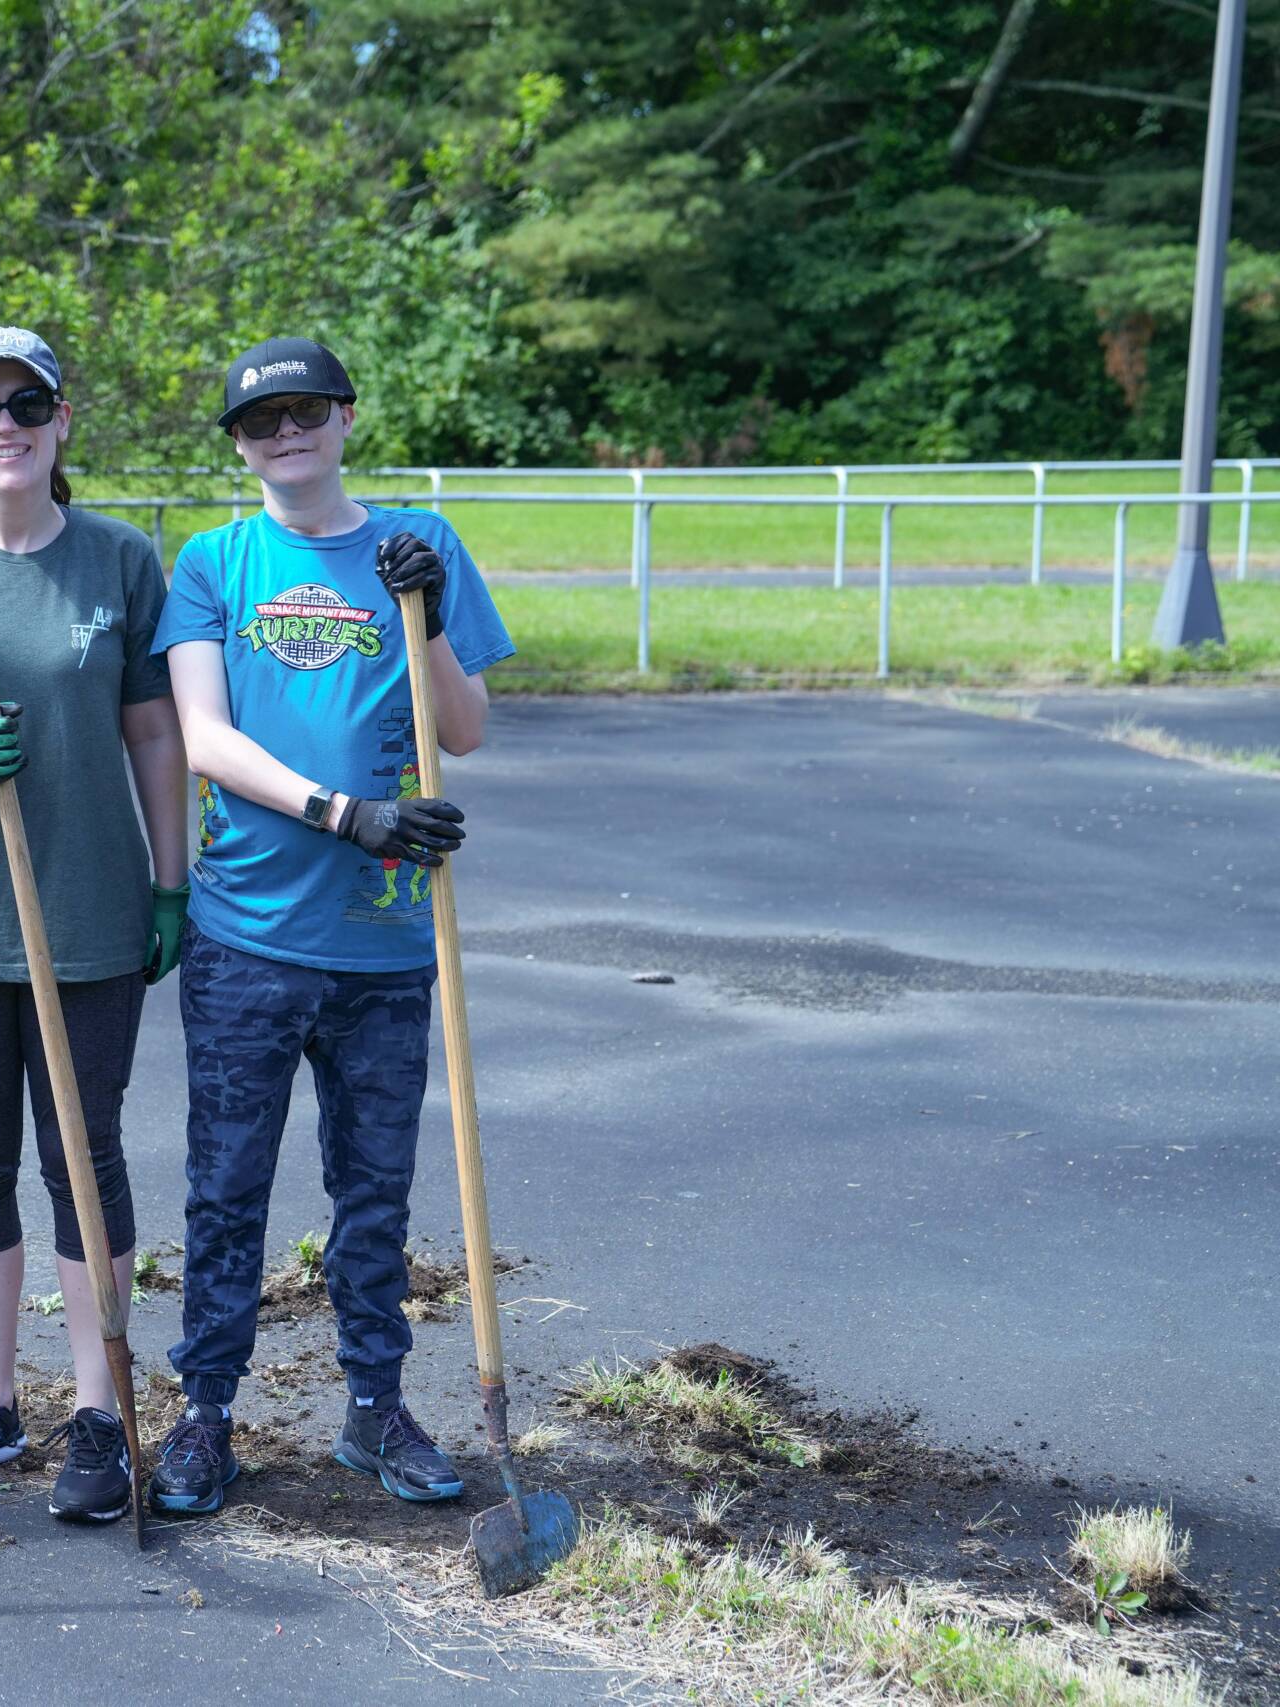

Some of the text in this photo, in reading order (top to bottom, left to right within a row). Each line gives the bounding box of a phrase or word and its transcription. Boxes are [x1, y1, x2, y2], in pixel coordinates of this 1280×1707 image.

[257, 604, 370, 620] TEENAGE MUTANT NINJA
[236, 616, 383, 657] TURTLES
